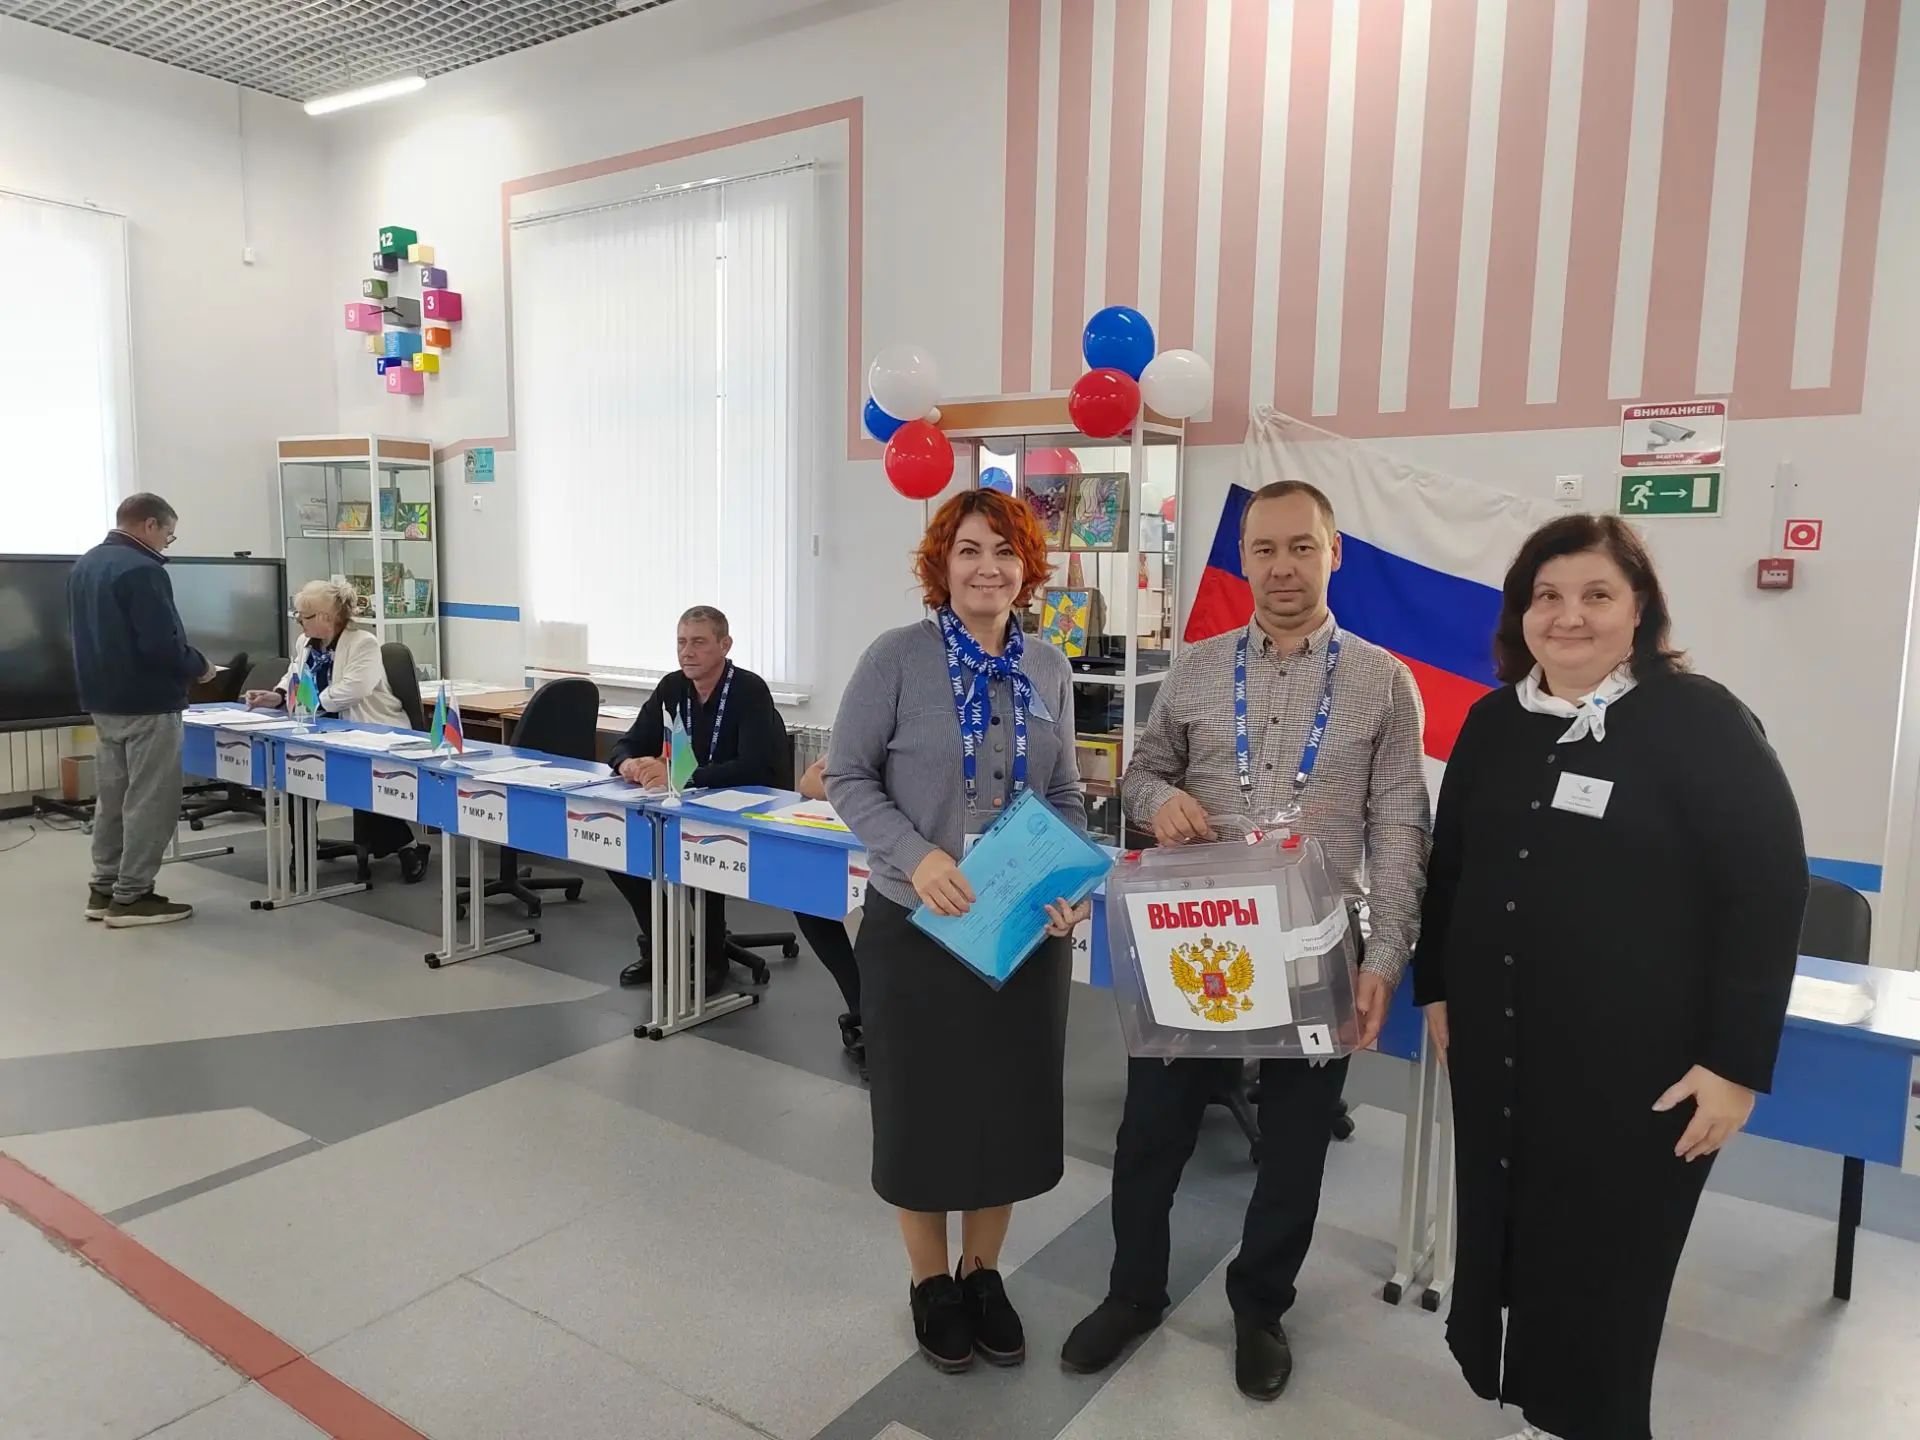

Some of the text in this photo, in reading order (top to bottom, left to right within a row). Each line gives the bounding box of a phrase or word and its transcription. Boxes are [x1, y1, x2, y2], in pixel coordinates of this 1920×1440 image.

[380, 232, 393, 248] 12
[422, 270, 429, 283] 2
[427, 296, 434, 310] 3
[348, 309, 355, 323] 9
[378, 359, 385, 372] 7
[389, 371, 396, 387] 6
[1633, 405, 1716, 417] ВНИМАНИЕ!!!
[947, 648, 960, 668] УИК
[951, 675, 964, 696] УИК
[971, 701, 983, 725] УИК
[1014, 705, 1025, 726] УИК
[1235, 649, 1249, 774] УИК УИК УИК УИК
[1307, 725, 1324, 748] УИК
[1318, 694, 1332, 717] УИК
[963, 733, 975, 757] УИК
[1016, 735, 1027, 757] УИК
[242, 758, 249, 766] 11
[287, 767, 292, 775] 7
[292, 767, 306, 778] МКР
[316, 773, 325, 782] 10
[377, 785, 414, 800] 7 МКР д. 9
[462, 805, 503, 821] 7 МКР д. 7
[573, 828, 622, 847] 7 МКР д. 6
[684, 850, 747, 873] 3 МКР д. 26
[851, 886, 860, 898] 3
[1147, 898, 1260, 930] ВЫБОРЫ
[1309, 1032, 1321, 1045] 1
